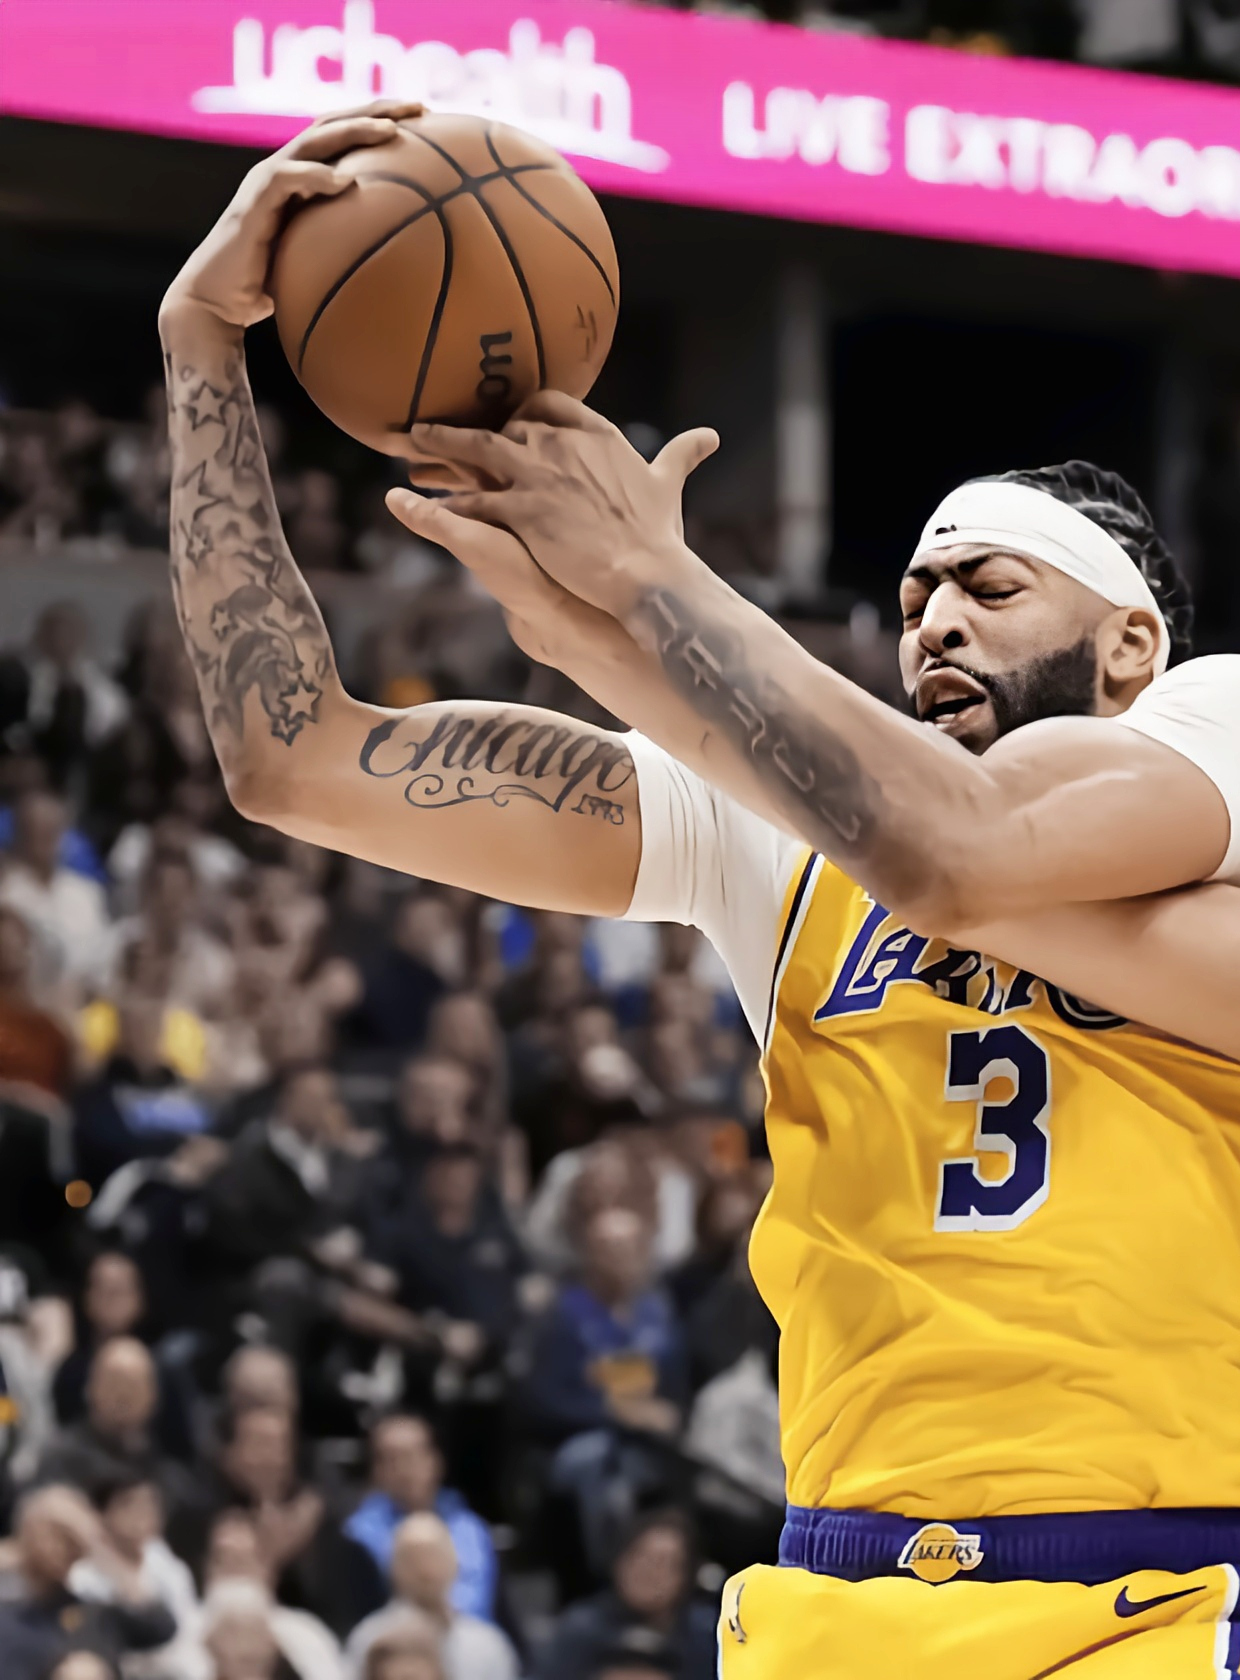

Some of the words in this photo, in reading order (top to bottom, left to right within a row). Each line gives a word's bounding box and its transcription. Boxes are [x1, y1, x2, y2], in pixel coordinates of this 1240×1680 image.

[722, 81, 891, 176] LIVE
[359, 709, 636, 812] Chicago
[933, 1021, 1050, 1232] 3
